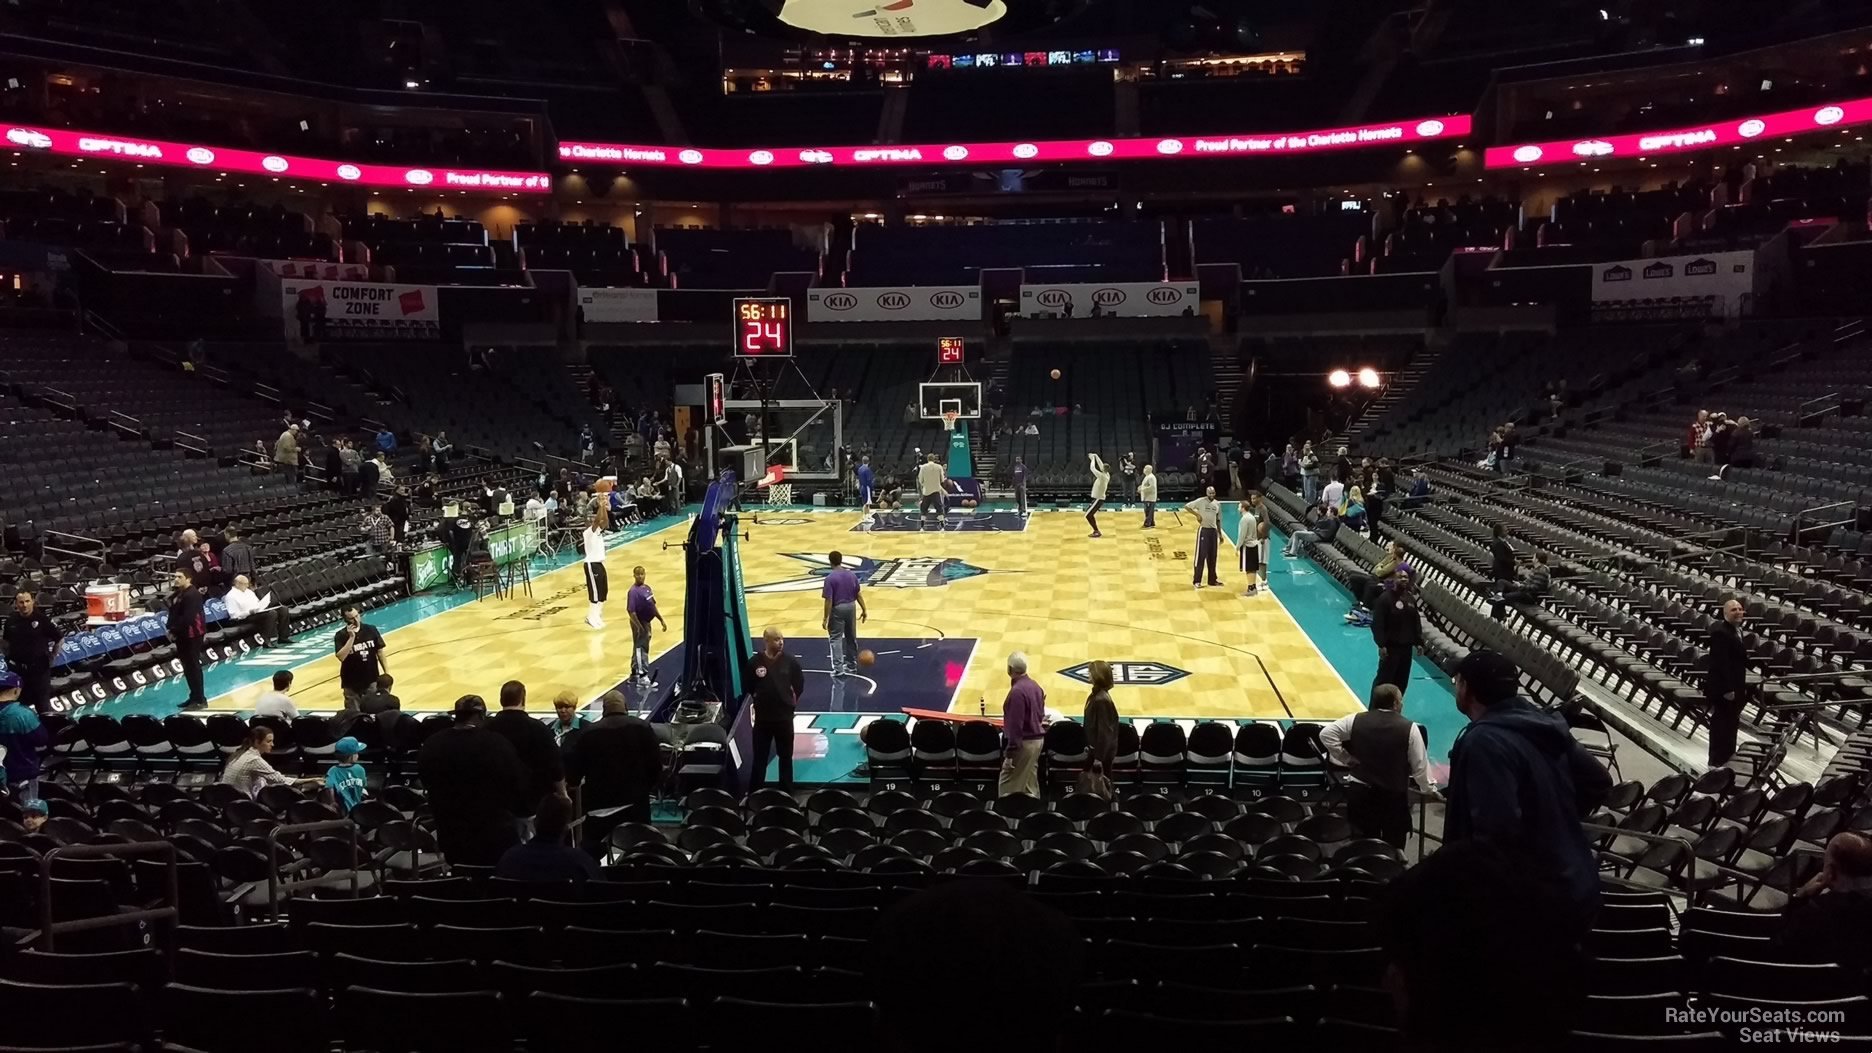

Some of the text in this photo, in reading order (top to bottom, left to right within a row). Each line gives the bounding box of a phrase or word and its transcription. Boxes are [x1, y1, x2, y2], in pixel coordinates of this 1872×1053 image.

[1195, 139, 1229, 152] Proud
[1230, 138, 1272, 151] Partner
[1273, 136, 1287, 149] of
[332, 287, 394, 301] COMFORT
[1043, 294, 1065, 304] KIA
[1097, 293, 1120, 303] KIA
[1152, 292, 1175, 302] KIA
[829, 297, 852, 307] KIA
[883, 296, 905, 306] KIA
[936, 295, 958, 305] KIA
[345, 302, 380, 315] ZONE
[741, 304, 785, 319] 56:11
[746, 321, 780, 349] 24
[943, 348, 959, 360] 24
[885, 783, 896, 791] 19
[930, 783, 941, 791] 18
[1065, 785, 1074, 793] 15
[1252, 789, 1261, 797] 10
